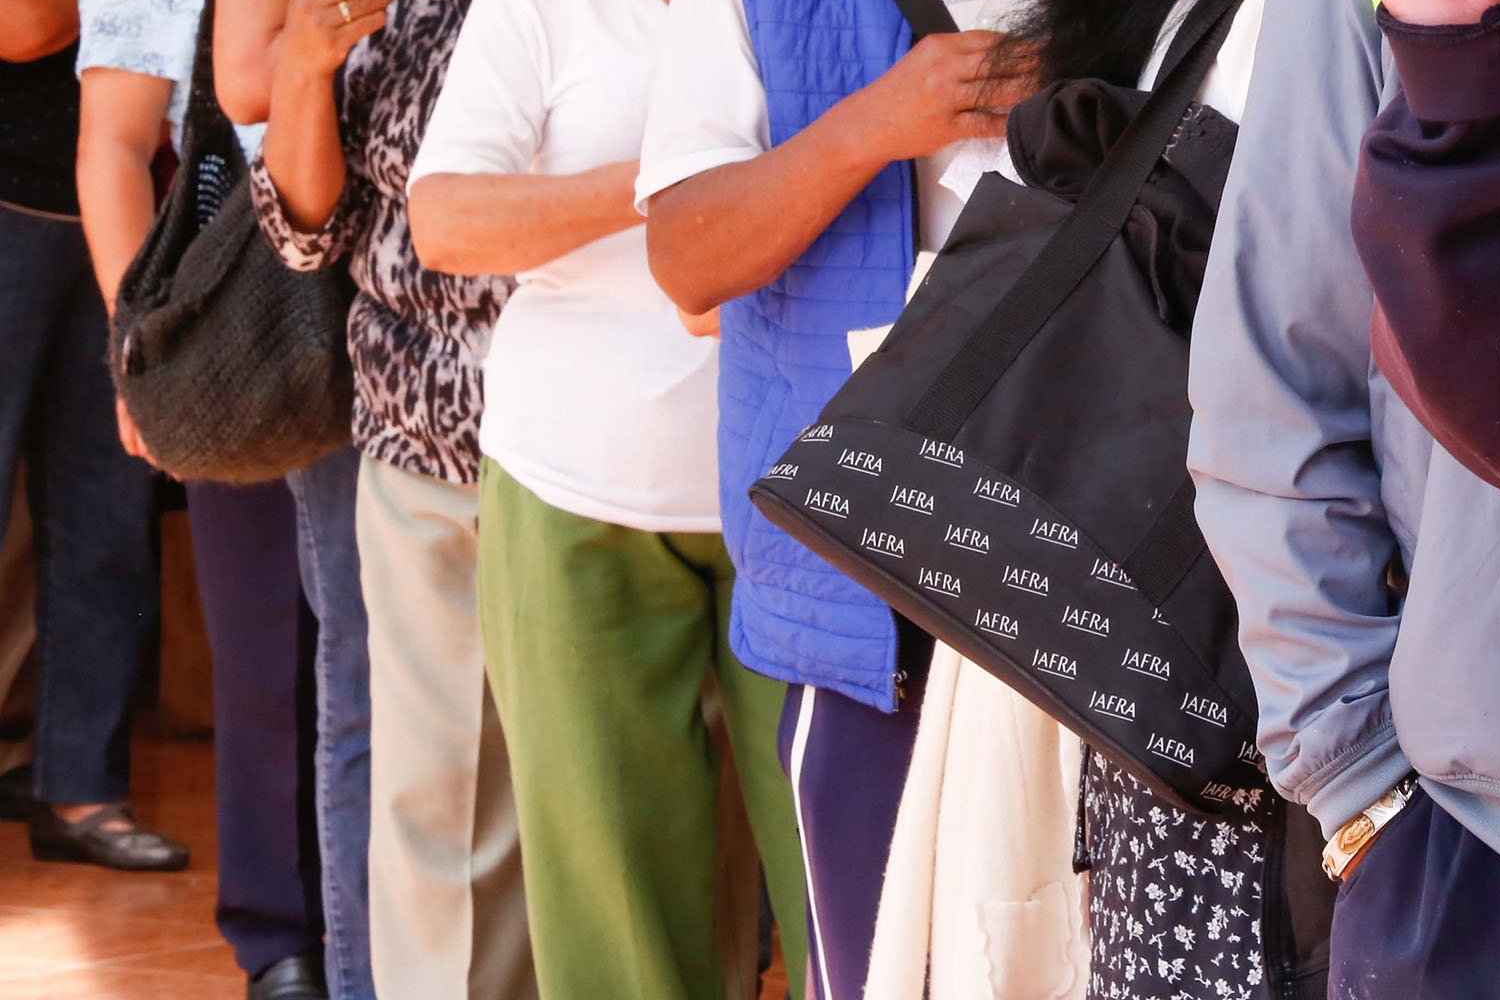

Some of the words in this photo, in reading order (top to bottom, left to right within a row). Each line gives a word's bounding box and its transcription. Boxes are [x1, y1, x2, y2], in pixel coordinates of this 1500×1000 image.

[838, 448, 883, 472] JAFRA
[918, 438, 965, 464] JAFRA
[767, 463, 799, 477] AFRA
[804, 488, 849, 514] JAFRA
[890, 485, 934, 510] JAFRA
[973, 477, 1020, 503] JAFRA
[861, 528, 905, 554] JAFRA
[944, 524, 990, 550] JAFRA
[1030, 518, 1079, 544] JAFRA
[918, 567, 961, 593] JAFRA
[1002, 565, 1049, 592] JAFRA
[975, 608, 1019, 635] JAFRA
[1062, 605, 1110, 633] JAFRA
[1032, 649, 1077, 675] JAFRA
[1121, 648, 1170, 676] JAFRA
[1088, 690, 1136, 717] JAFRA
[1180, 692, 1227, 723] JAFRA
[1146, 733, 1194, 763] JAFRA
